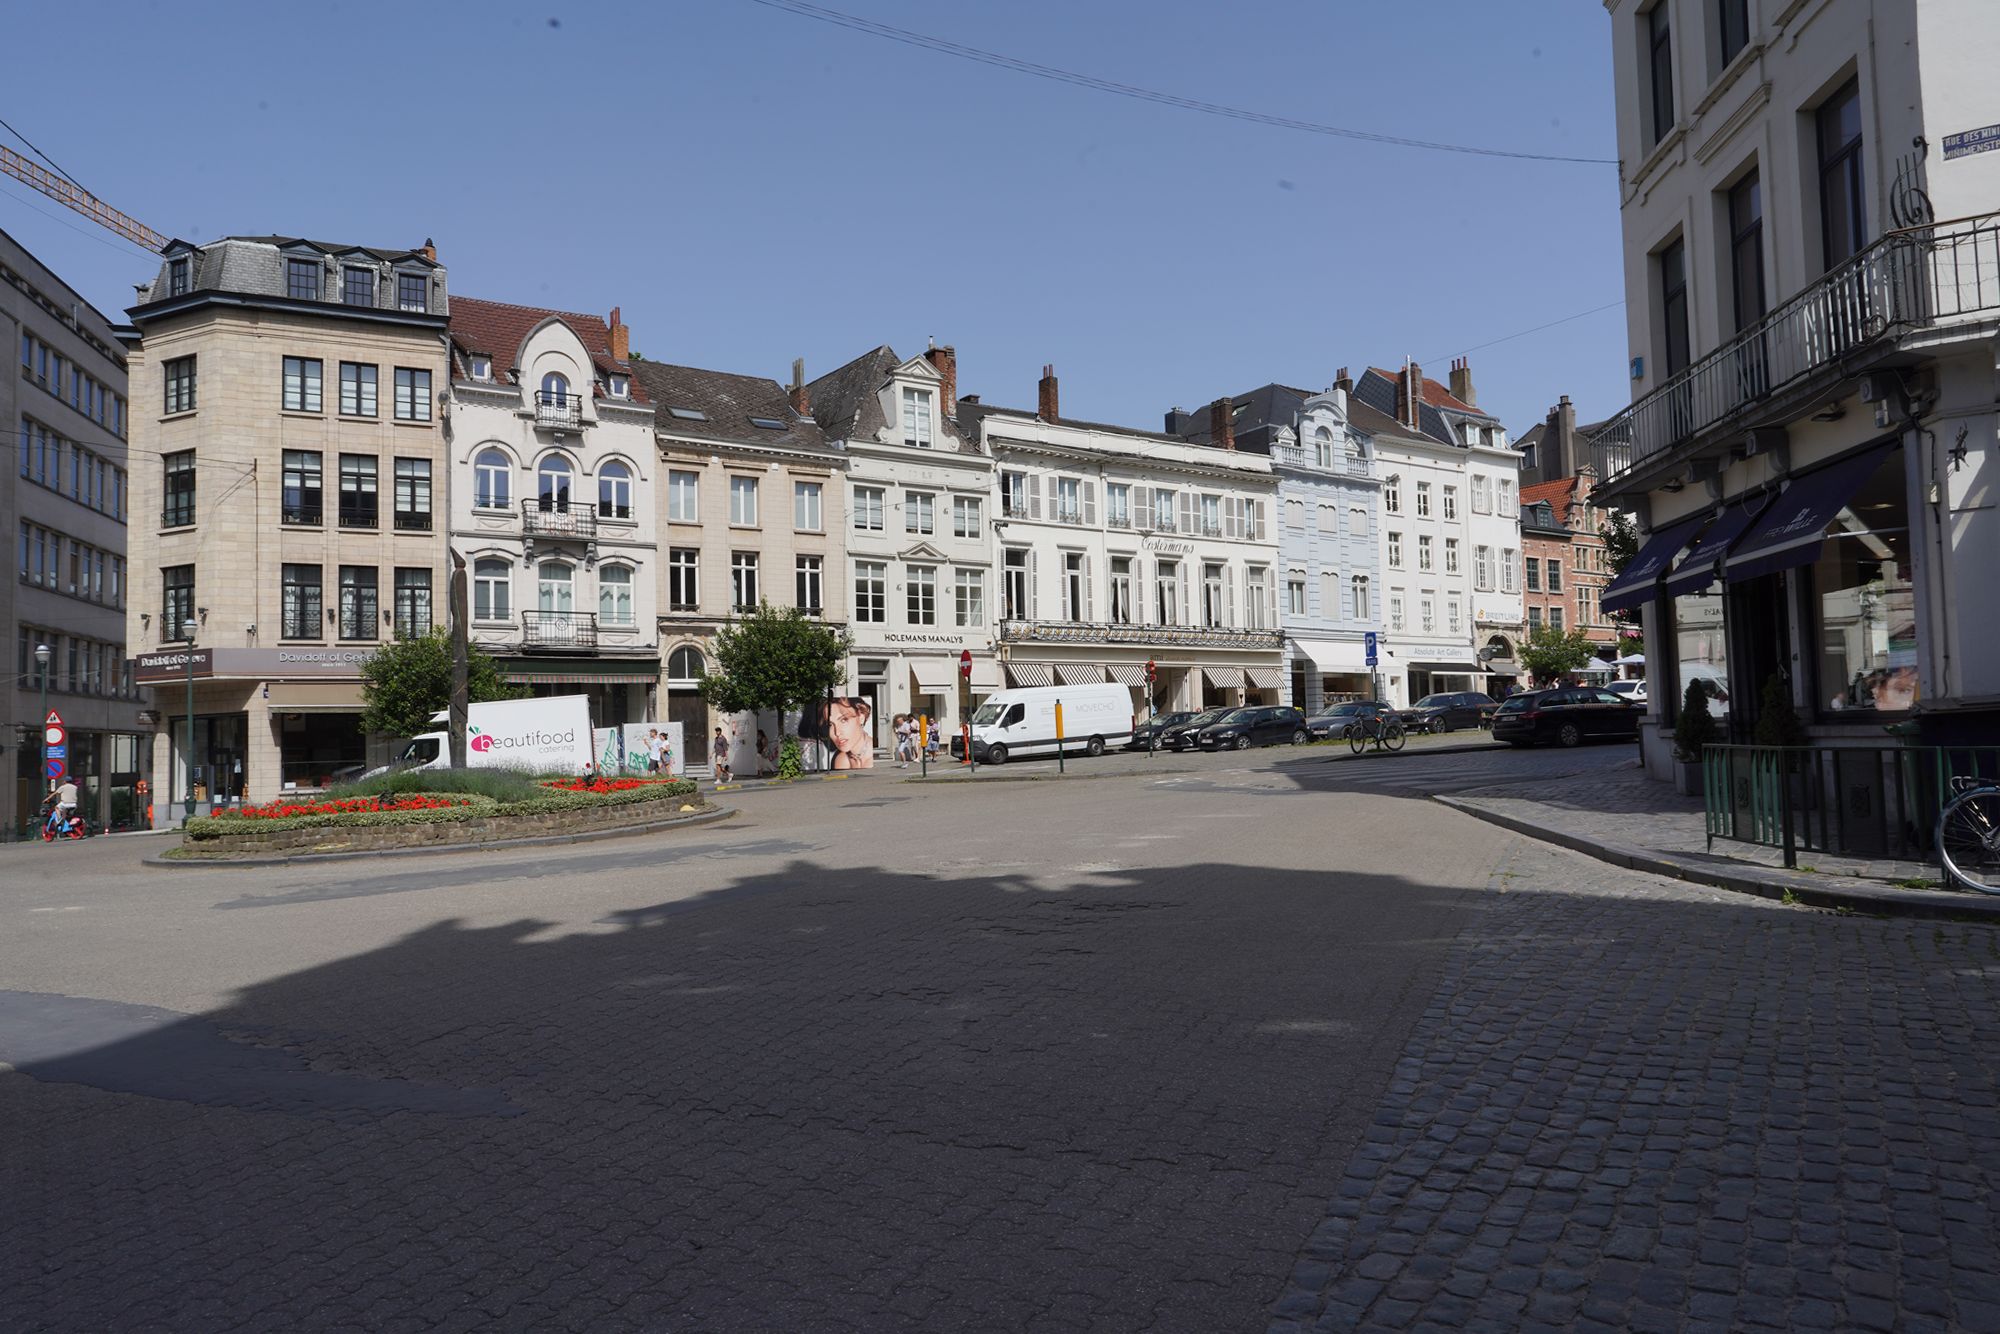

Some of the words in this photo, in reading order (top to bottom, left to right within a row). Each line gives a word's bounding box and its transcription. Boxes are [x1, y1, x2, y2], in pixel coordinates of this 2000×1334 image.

[1946, 135, 1962, 147] RUE
[1964, 130, 1979, 143] DES
[884, 633, 927, 643] HOLEMANS
[928, 635, 964, 644] MANALYS
[1366, 636, 1374, 654] P
[280, 652, 326, 662] Davidoff
[329, 652, 340, 662] of
[1414, 648, 1436, 656] Absolute
[1437, 648, 1446, 656] Art
[1446, 648, 1463, 657] Gallery
[178, 654, 206, 664] Geeva
[480, 728, 574, 750] beautifood
[538, 744, 574, 754] catering
